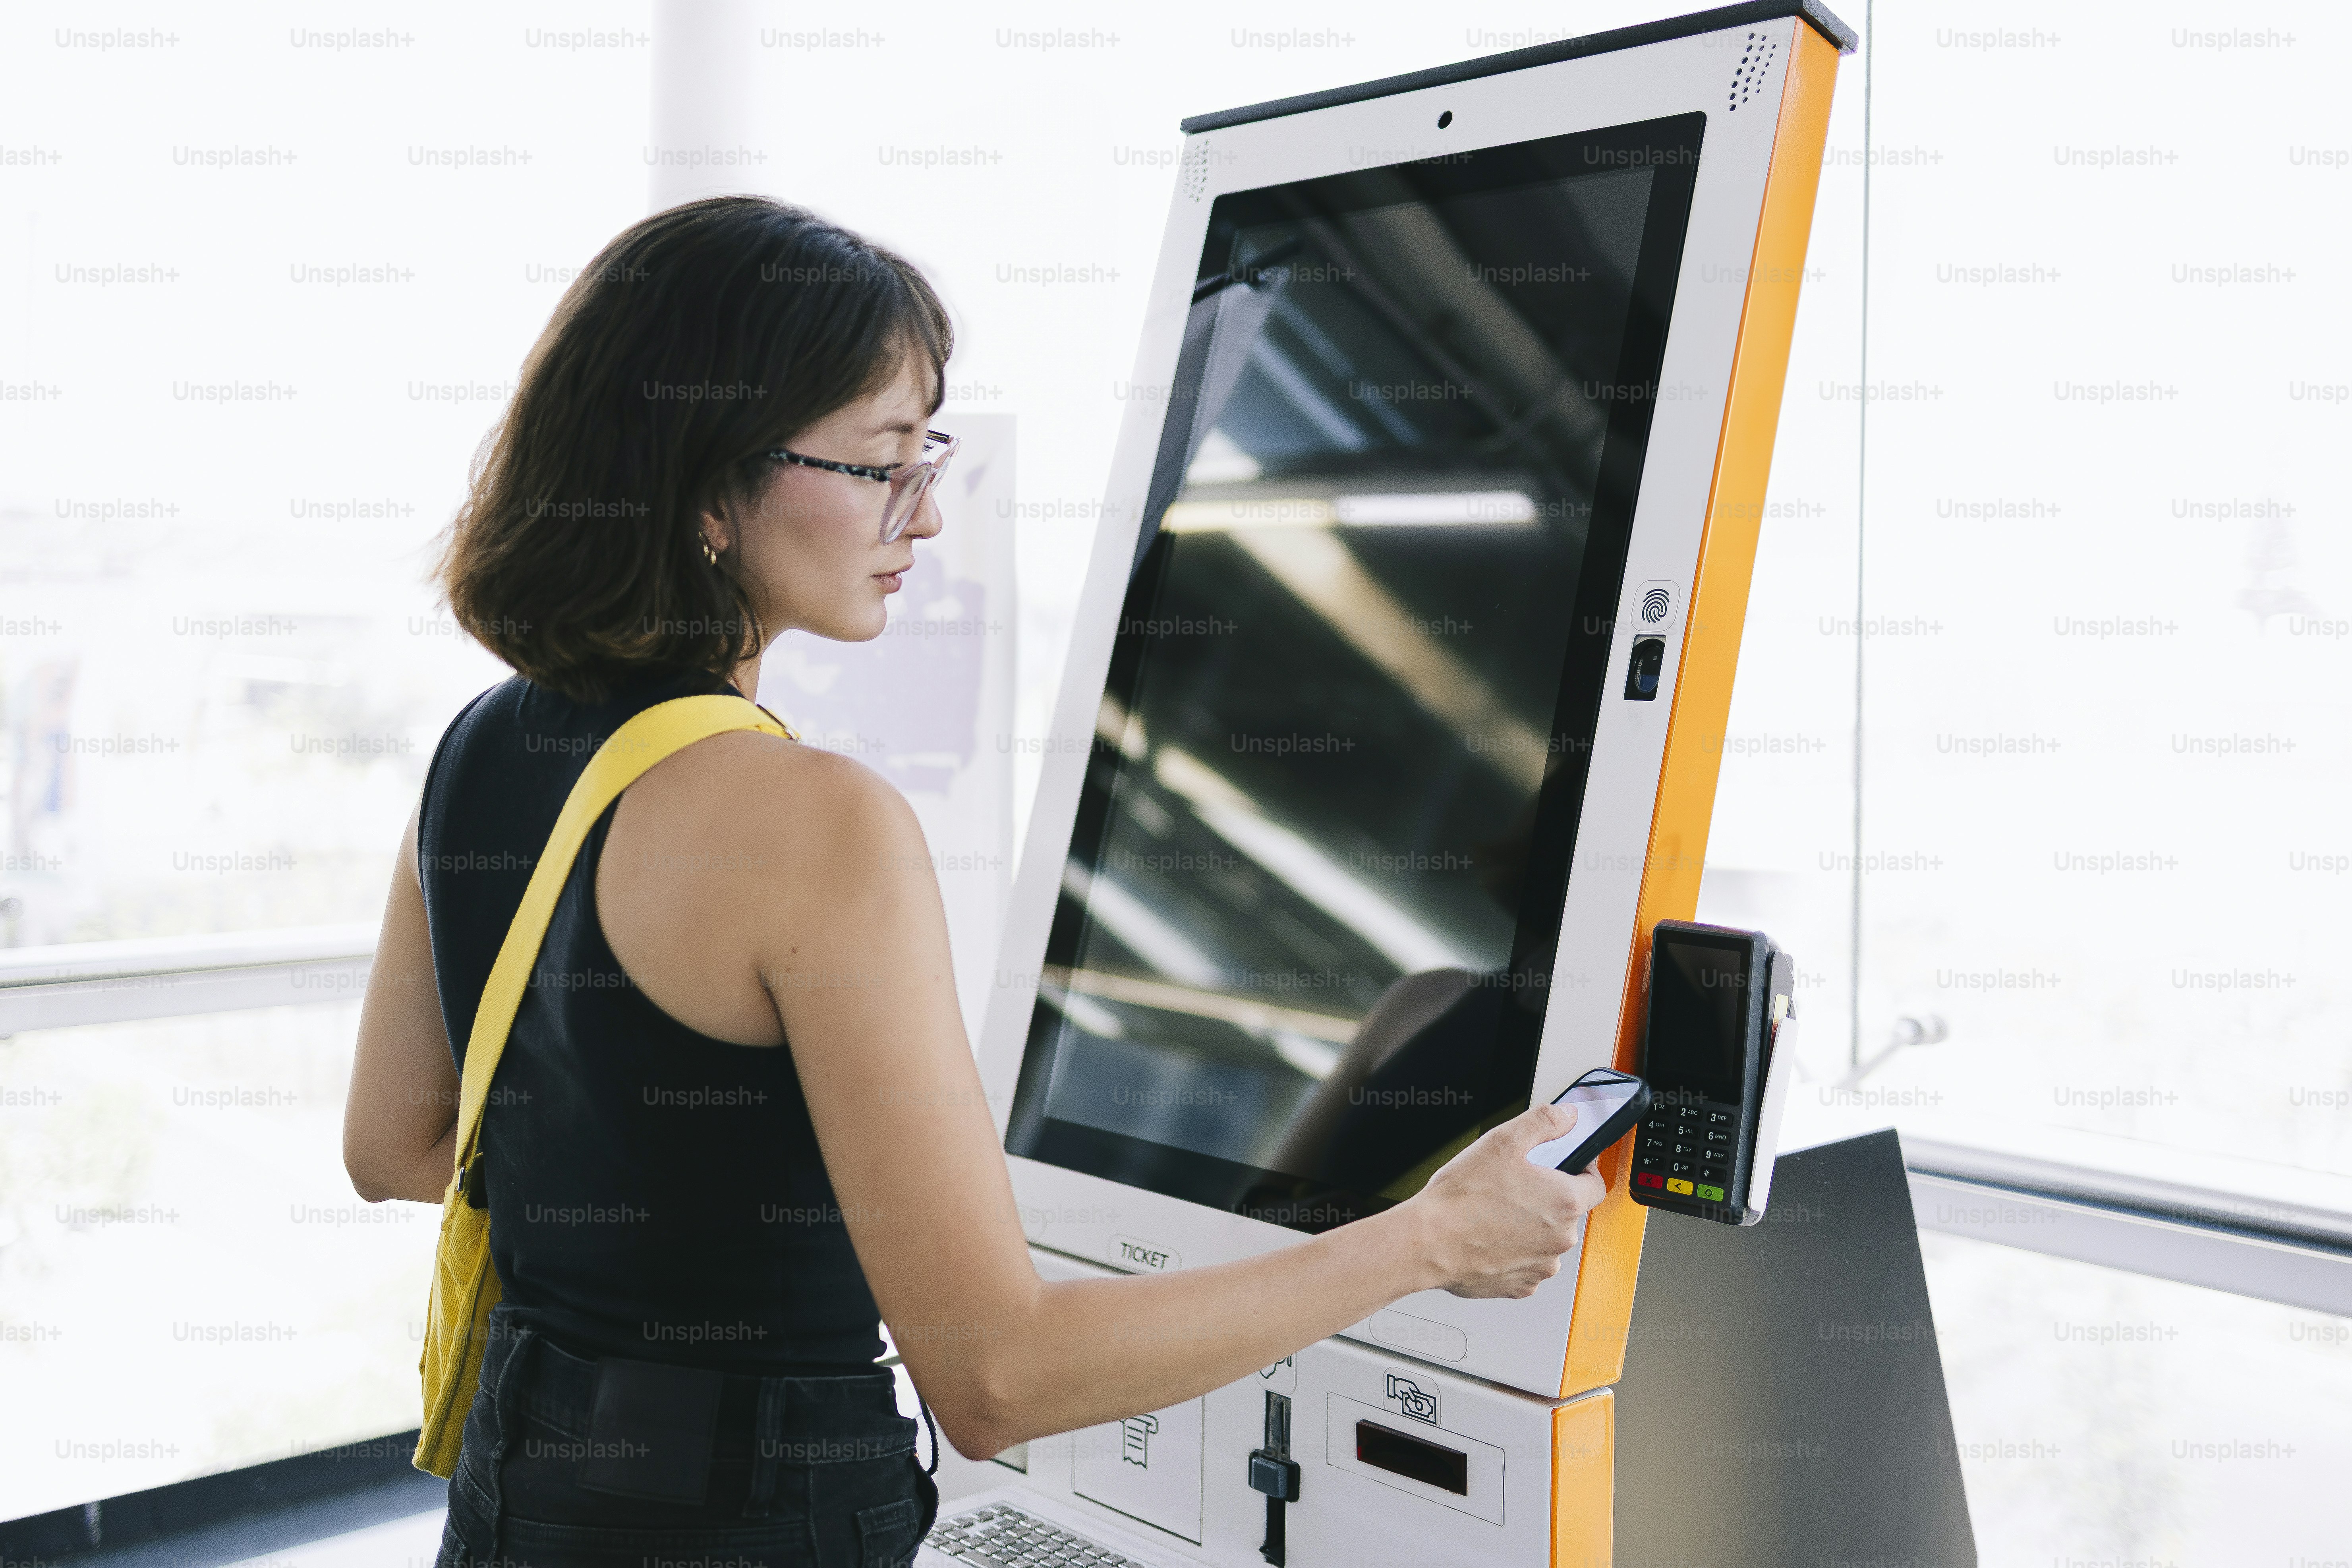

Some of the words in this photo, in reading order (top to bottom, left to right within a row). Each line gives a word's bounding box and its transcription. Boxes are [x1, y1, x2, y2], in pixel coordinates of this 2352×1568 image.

[1653, 1102, 1657, 1111] 1
[1681, 1108, 1686, 1116] 2
[1710, 1113, 1716, 1121] 3
[1678, 1126, 1684, 1135] 5
[1708, 1131, 1714, 1140] 6
[1647, 1139, 1652, 1147] 7
[1676, 1144, 1681, 1153] 8
[1706, 1150, 1711, 1159] 9
[1674, 1163, 1679, 1171] 0
[1120, 1242, 1169, 1269] TICKET
